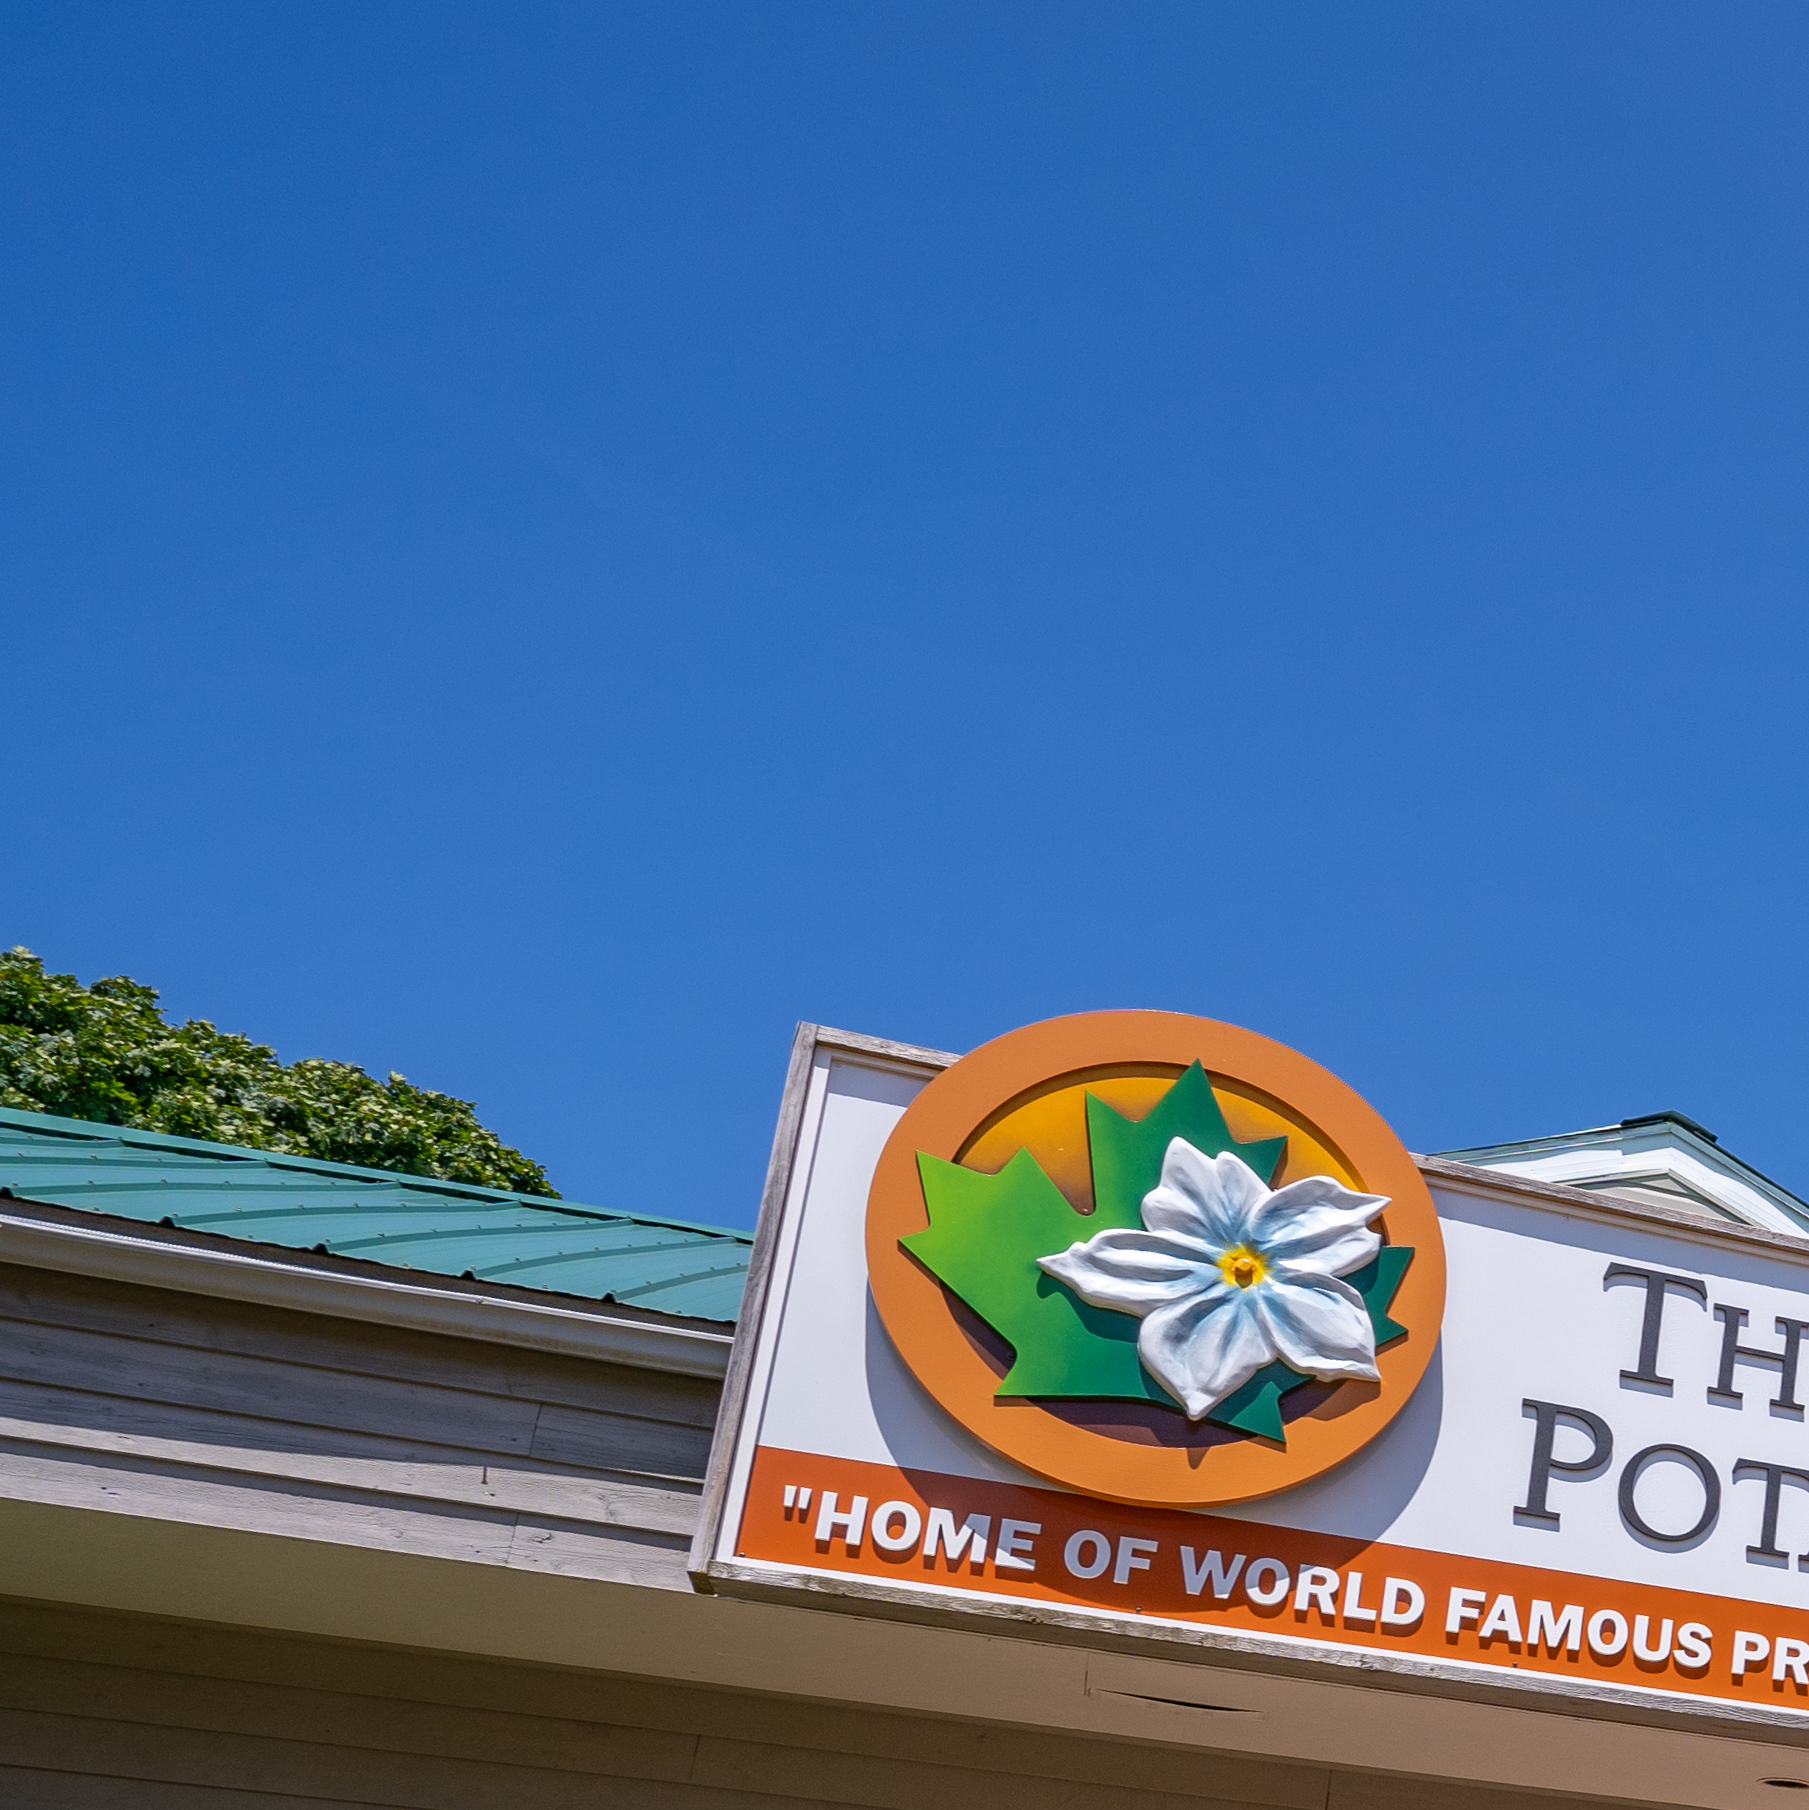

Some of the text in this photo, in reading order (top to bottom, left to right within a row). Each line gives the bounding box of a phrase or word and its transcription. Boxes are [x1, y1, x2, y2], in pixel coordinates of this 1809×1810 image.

[1063, 1530, 1158, 1586] OF
[1180, 1545, 1425, 1627] WORLD
[1445, 1586, 1712, 1669] FAMOUS
